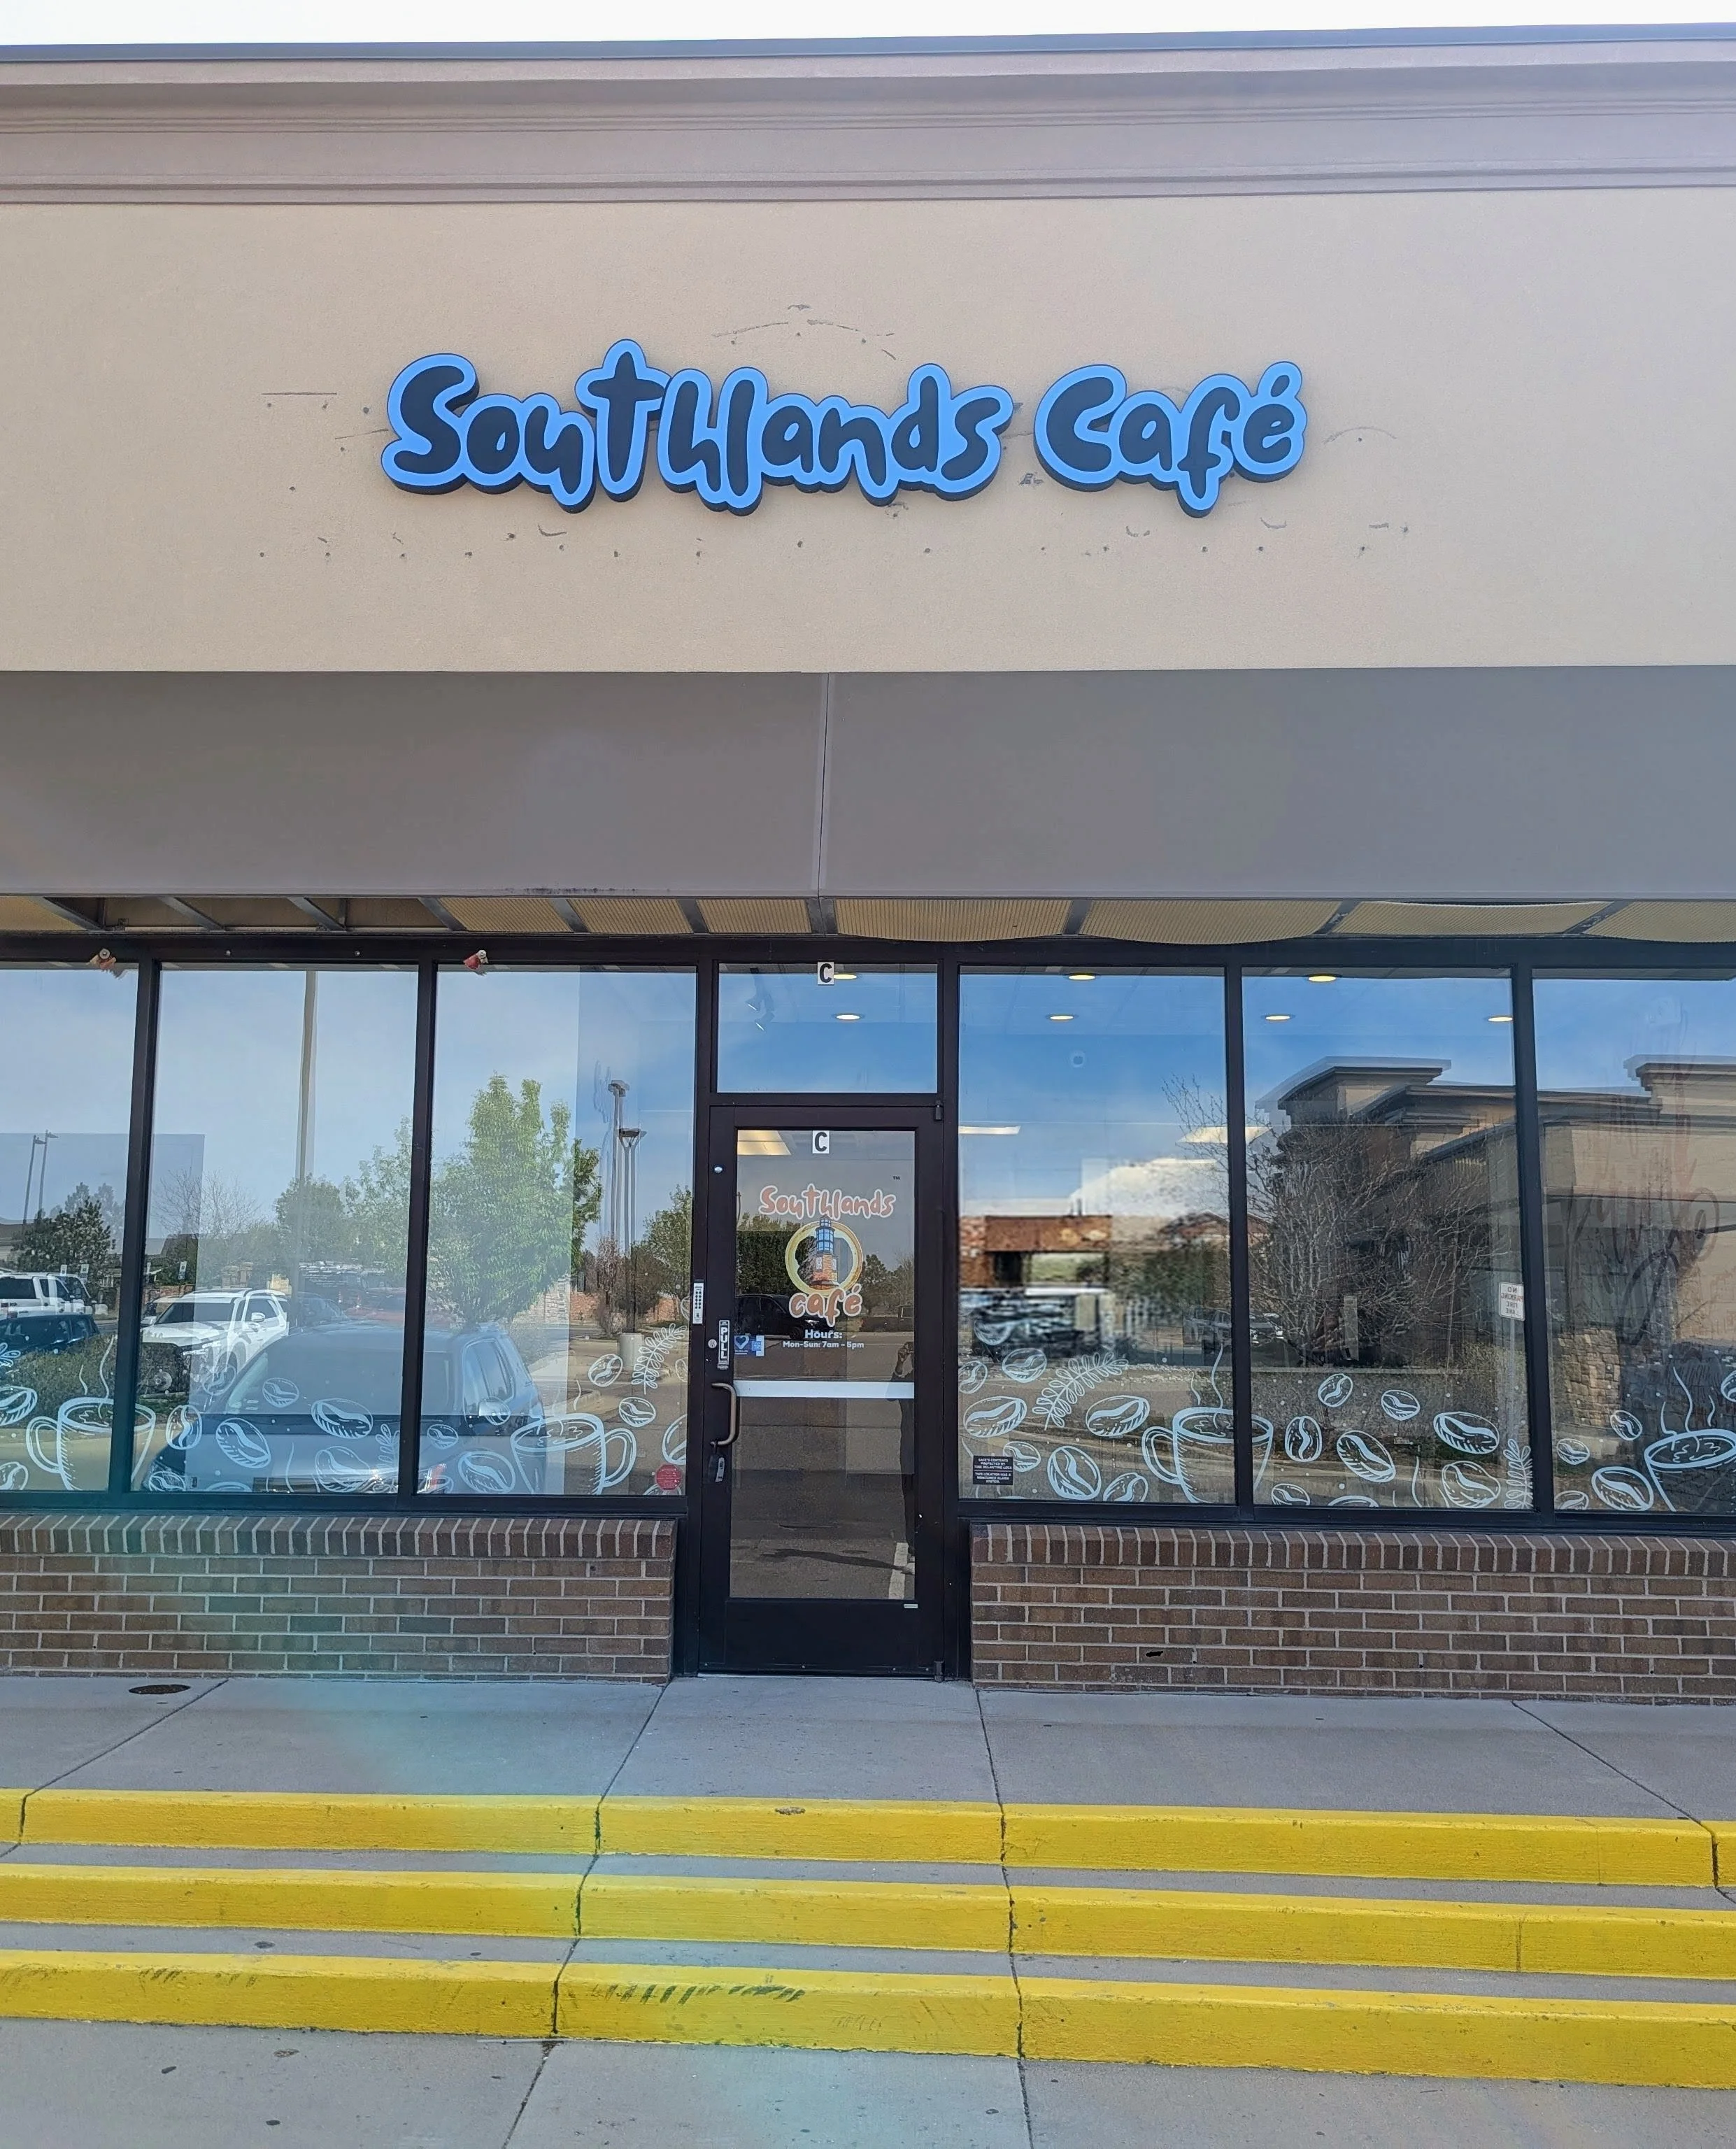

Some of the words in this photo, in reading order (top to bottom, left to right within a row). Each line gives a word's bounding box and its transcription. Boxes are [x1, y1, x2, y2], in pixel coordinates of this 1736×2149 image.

[381, 339, 1013, 515] Southlands
[1034, 361, 1307, 518] Café
[820, 963, 832, 983] C
[815, 1132, 827, 1151] C
[758, 1183, 896, 1221] Southlands
[789, 1284, 863, 1327] café
[804, 1329, 843, 1339] Hours:
[847, 1341, 865, 1349] 5pm
